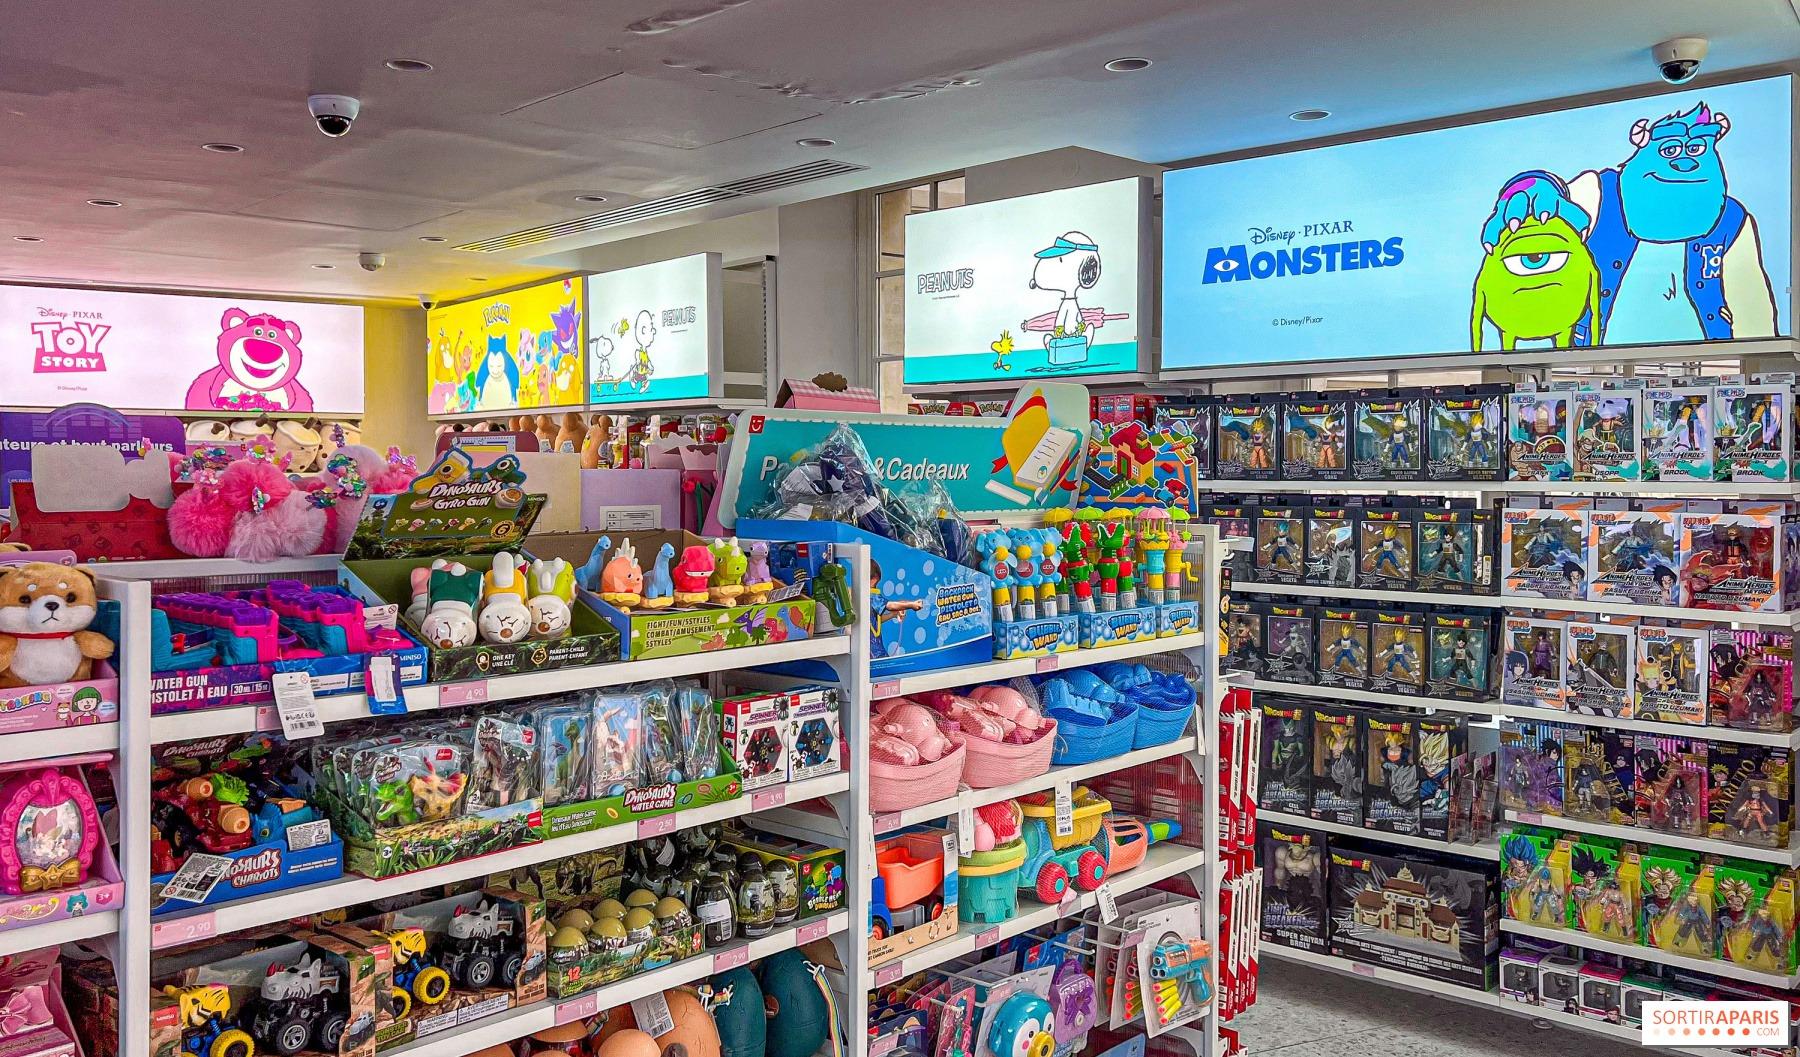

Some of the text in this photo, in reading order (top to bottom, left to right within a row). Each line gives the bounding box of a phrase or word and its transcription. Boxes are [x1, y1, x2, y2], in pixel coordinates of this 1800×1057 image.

[1248, 220, 1353, 245] Disney PIXAR
[1202, 236, 1405, 285] MONSTERS
[917, 268, 974, 294] PEANUTS
[36, 306, 103, 320] Disney PIXAR
[662, 306, 696, 328] PEANUTS
[1280, 316, 1323, 327] Disney/Pixar
[31, 321, 112, 354] TOY
[41, 356, 99, 369] STORY
[430, 479, 502, 497] DINOSAURS
[434, 497, 491, 509] GYRO GUN
[939, 584, 974, 597] BACKPACK
[646, 625, 715, 639] COMBAT/AMUSEMENT
[1034, 634, 1058, 649] WAND
[186, 675, 208, 687] GUN
[196, 686, 204, 699] À
[207, 686, 228, 698] EAU
[800, 703, 826, 712] SPINNER
[750, 711, 777, 720] SPINNER
[624, 783, 676, 805] DINOSAURS
[1710, 759, 1756, 820] NARUTO
[632, 799, 674, 811] WATER GAME
[234, 869, 279, 887] CHARIOTS
[186, 922, 211, 938] 2.90
[1276, 929, 1298, 940] SUPER
[1300, 934, 1324, 946] SAIYAN
[568, 967, 581, 981] 12
